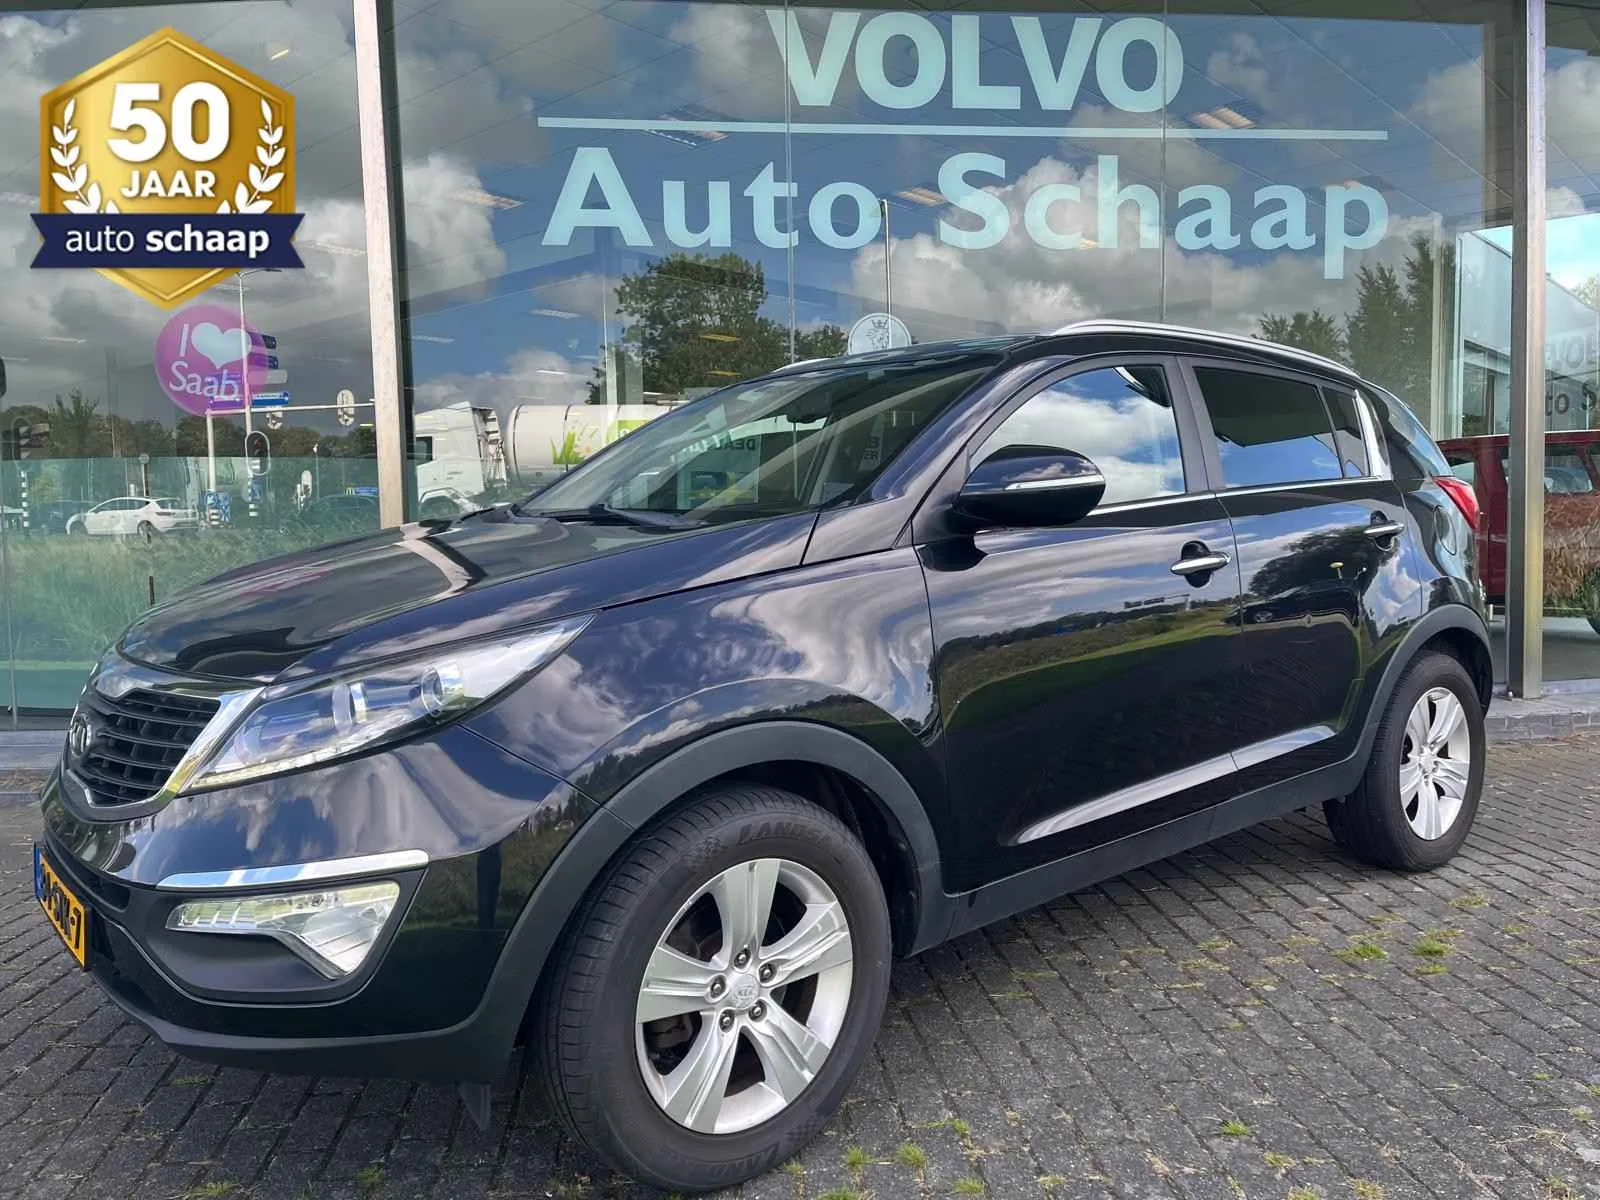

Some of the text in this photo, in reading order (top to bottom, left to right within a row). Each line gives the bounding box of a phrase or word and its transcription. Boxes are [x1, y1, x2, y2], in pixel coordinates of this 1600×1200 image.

[765, 9, 1184, 113] VOLVO
[541, 146, 1390, 280] Auto Schaap
[179, 323, 190, 358] I
[169, 360, 239, 401] Saab
